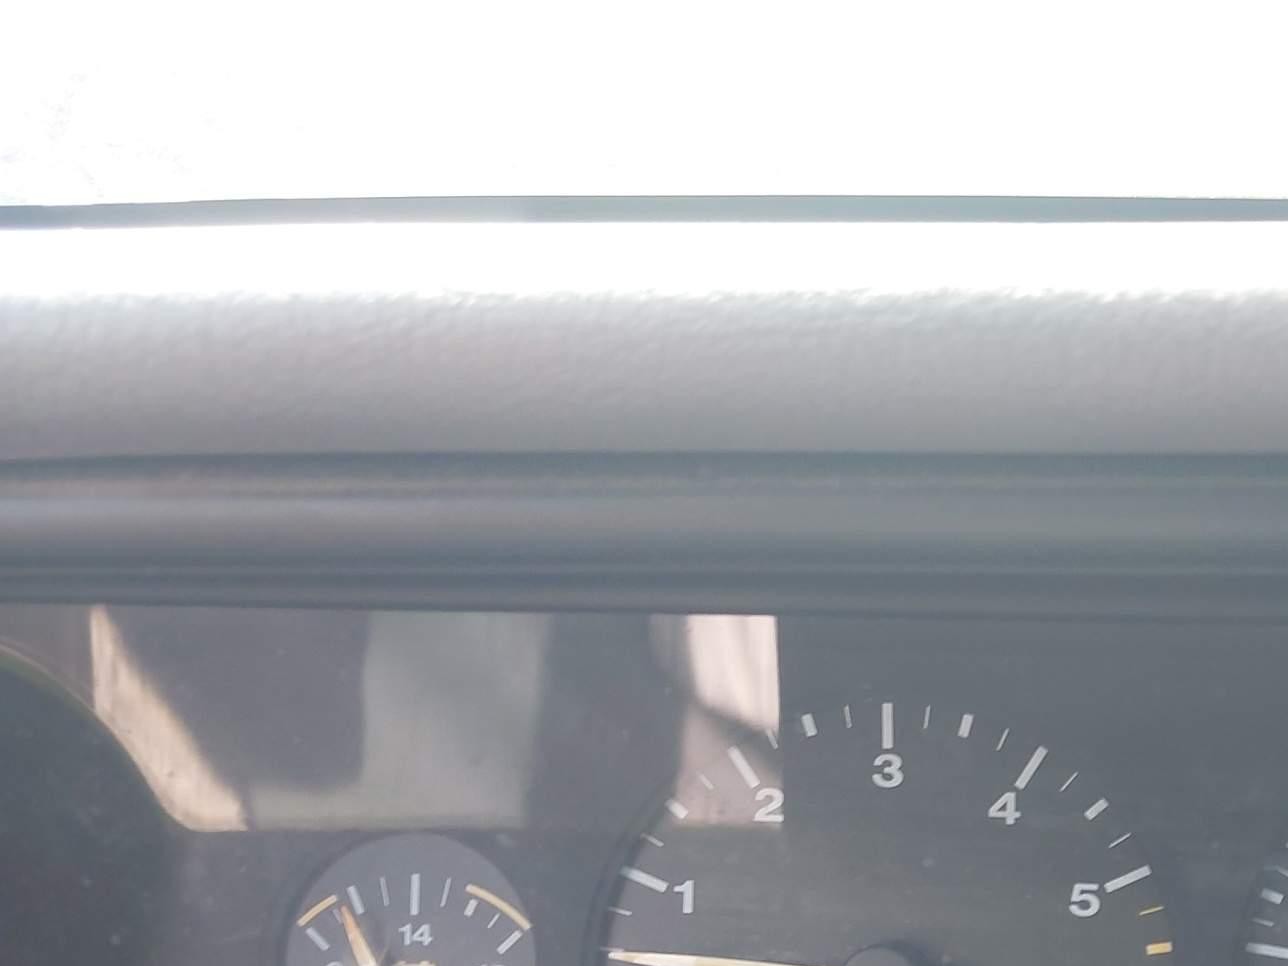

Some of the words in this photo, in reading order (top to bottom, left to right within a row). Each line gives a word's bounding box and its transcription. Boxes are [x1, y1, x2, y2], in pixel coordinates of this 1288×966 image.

[872, 754, 904, 788] 3
[754, 788, 785, 823] 2
[988, 792, 1020, 825] 4
[673, 880, 694, 914] 1
[1069, 883, 1100, 917] 5
[399, 923, 434, 946] 14
